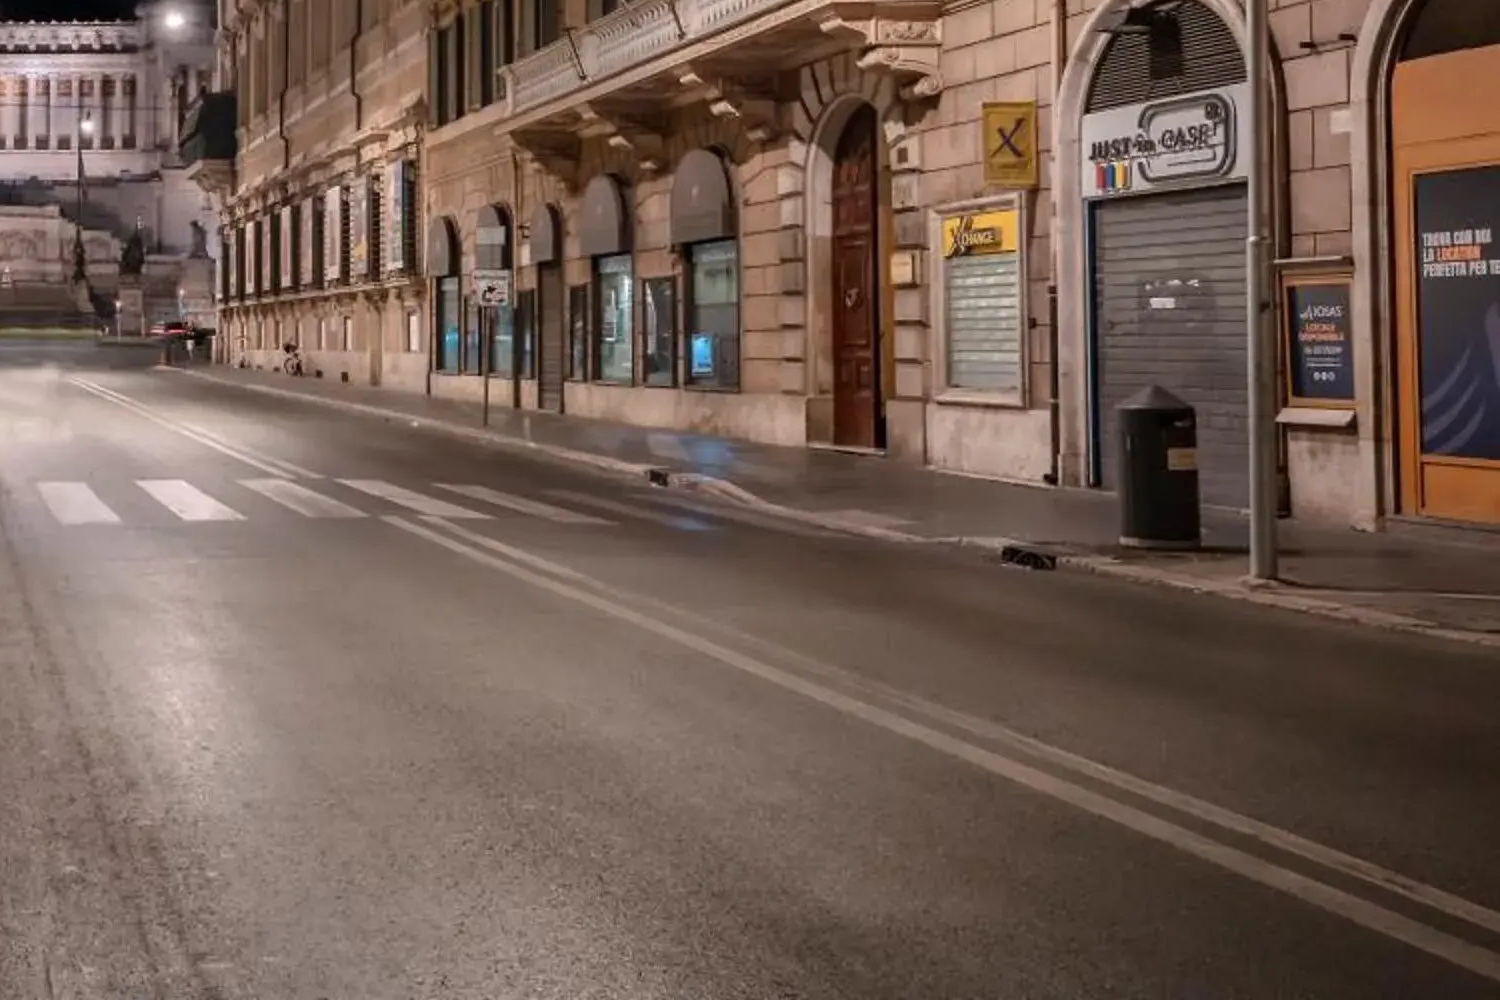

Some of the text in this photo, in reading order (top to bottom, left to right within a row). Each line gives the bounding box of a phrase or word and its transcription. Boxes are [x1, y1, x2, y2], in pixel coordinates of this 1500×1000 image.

[1088, 138, 1133, 160] JUST
[1423, 262, 1467, 278] PERFETTA
[1469, 260, 1487, 276] PER
